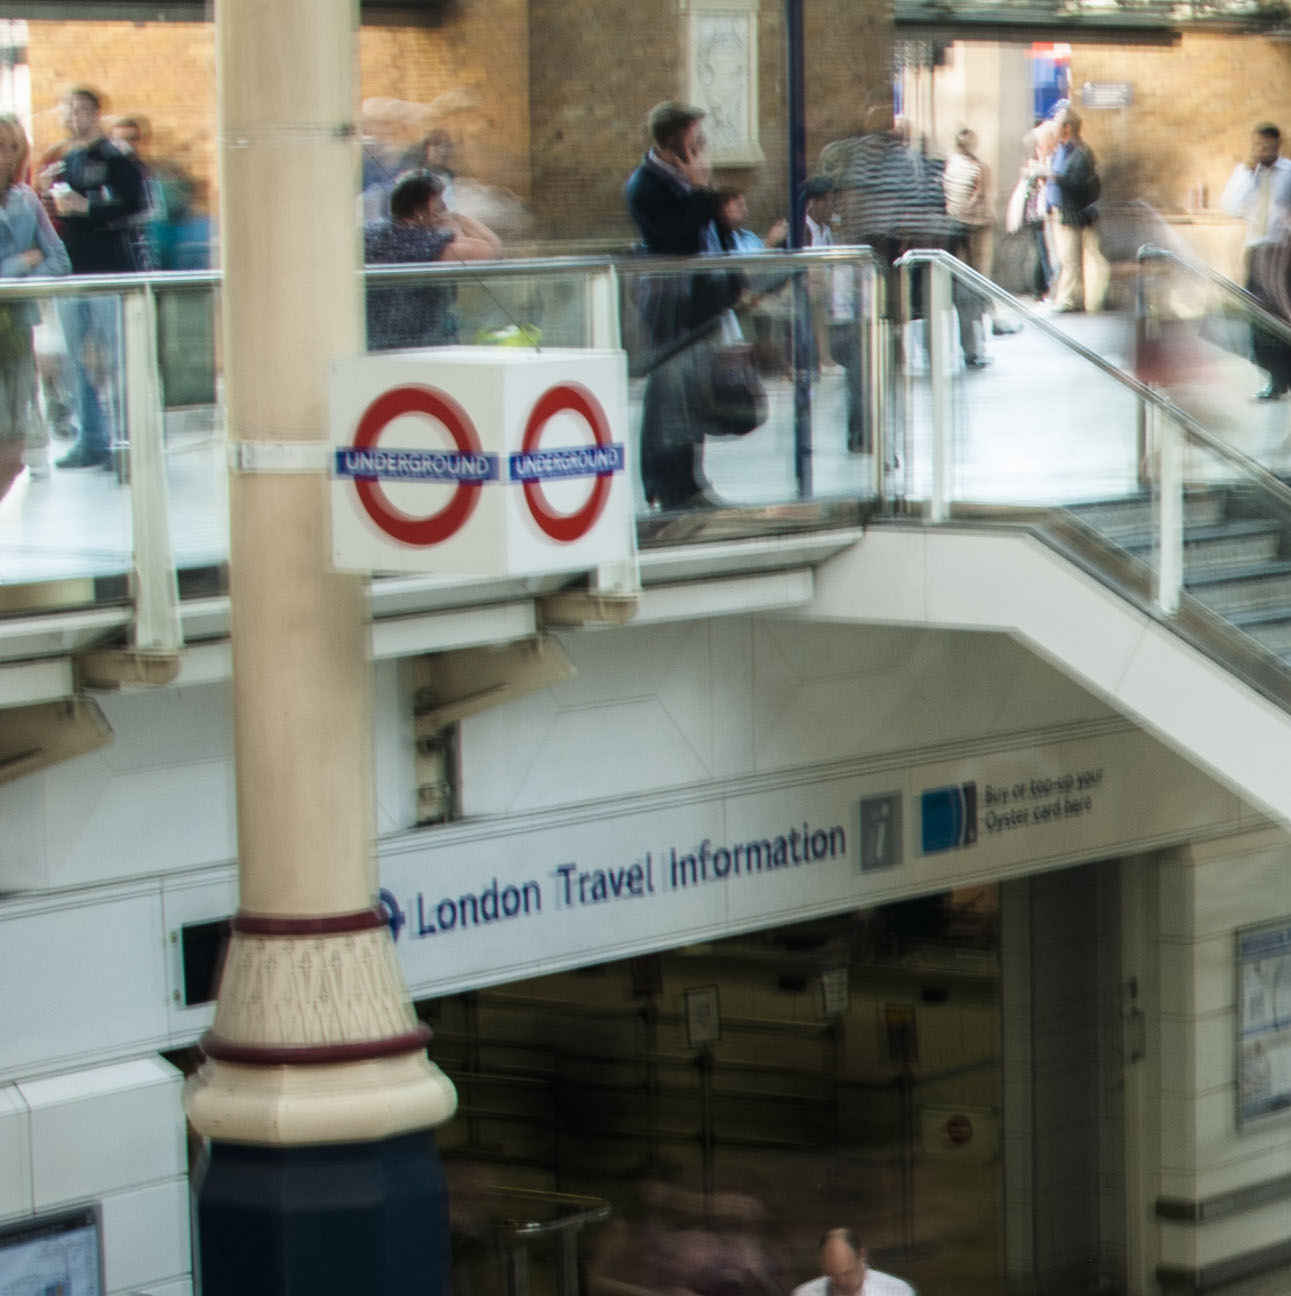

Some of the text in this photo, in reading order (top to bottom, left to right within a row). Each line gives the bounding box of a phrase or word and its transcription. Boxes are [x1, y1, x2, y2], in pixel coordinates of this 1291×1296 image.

[345, 452, 490, 475] UNDERGROUND
[516, 449, 618, 475] UNDERGROUND
[415, 821, 847, 937] London Travel Information
